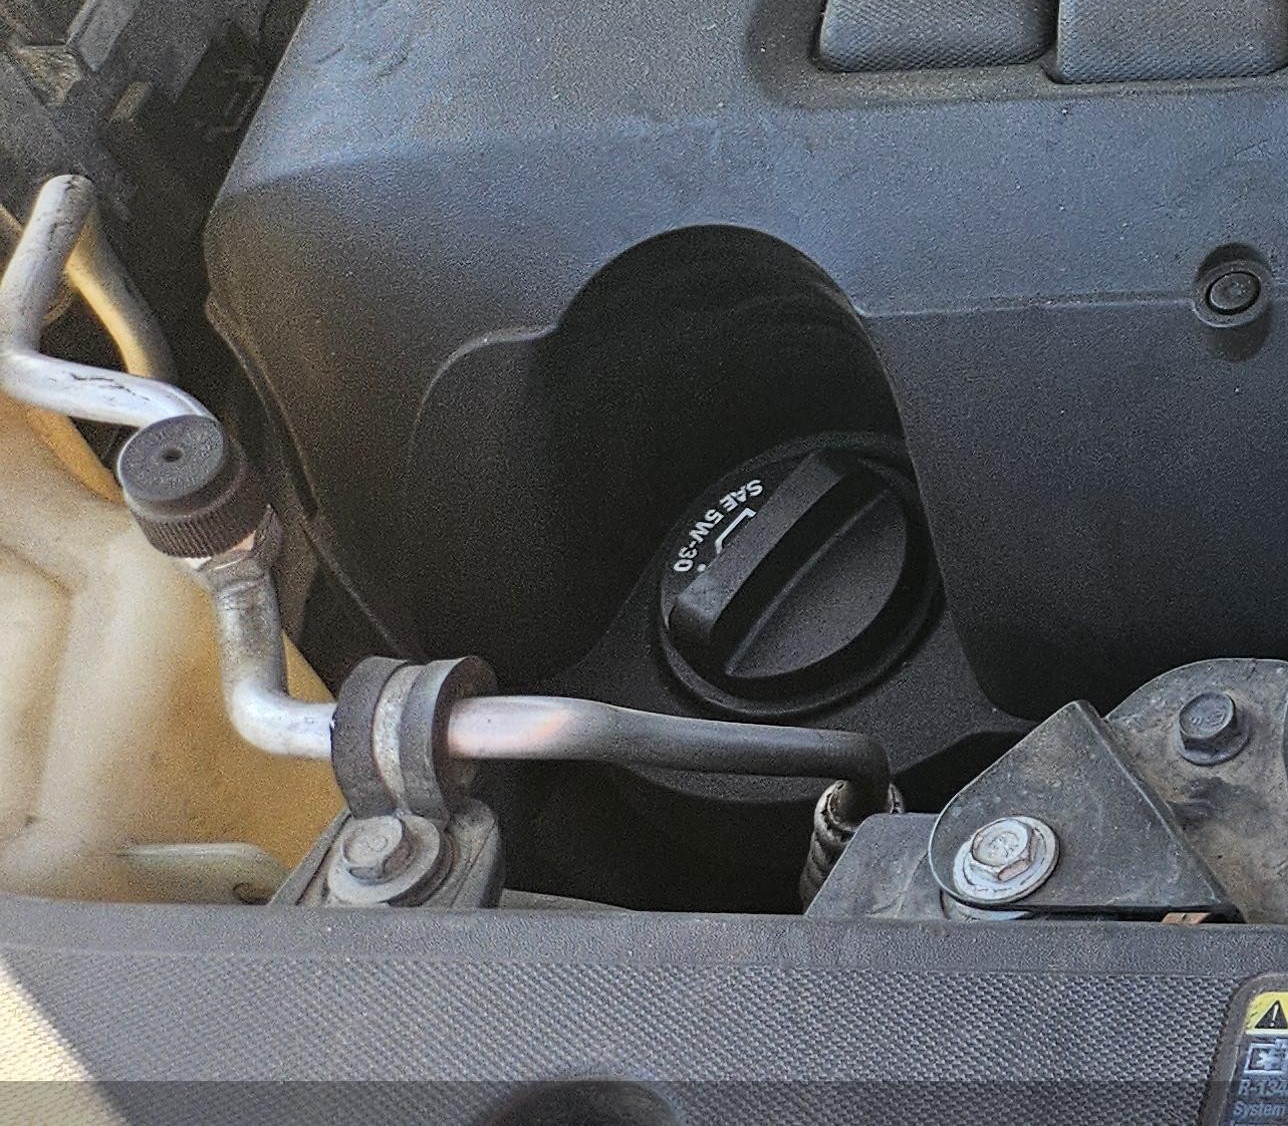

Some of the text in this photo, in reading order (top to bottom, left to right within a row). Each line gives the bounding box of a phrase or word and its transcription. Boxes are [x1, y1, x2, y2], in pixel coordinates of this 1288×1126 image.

[672, 478, 764, 573] SAE 5W-30
[1232, 1100, 1286, 1119] System
